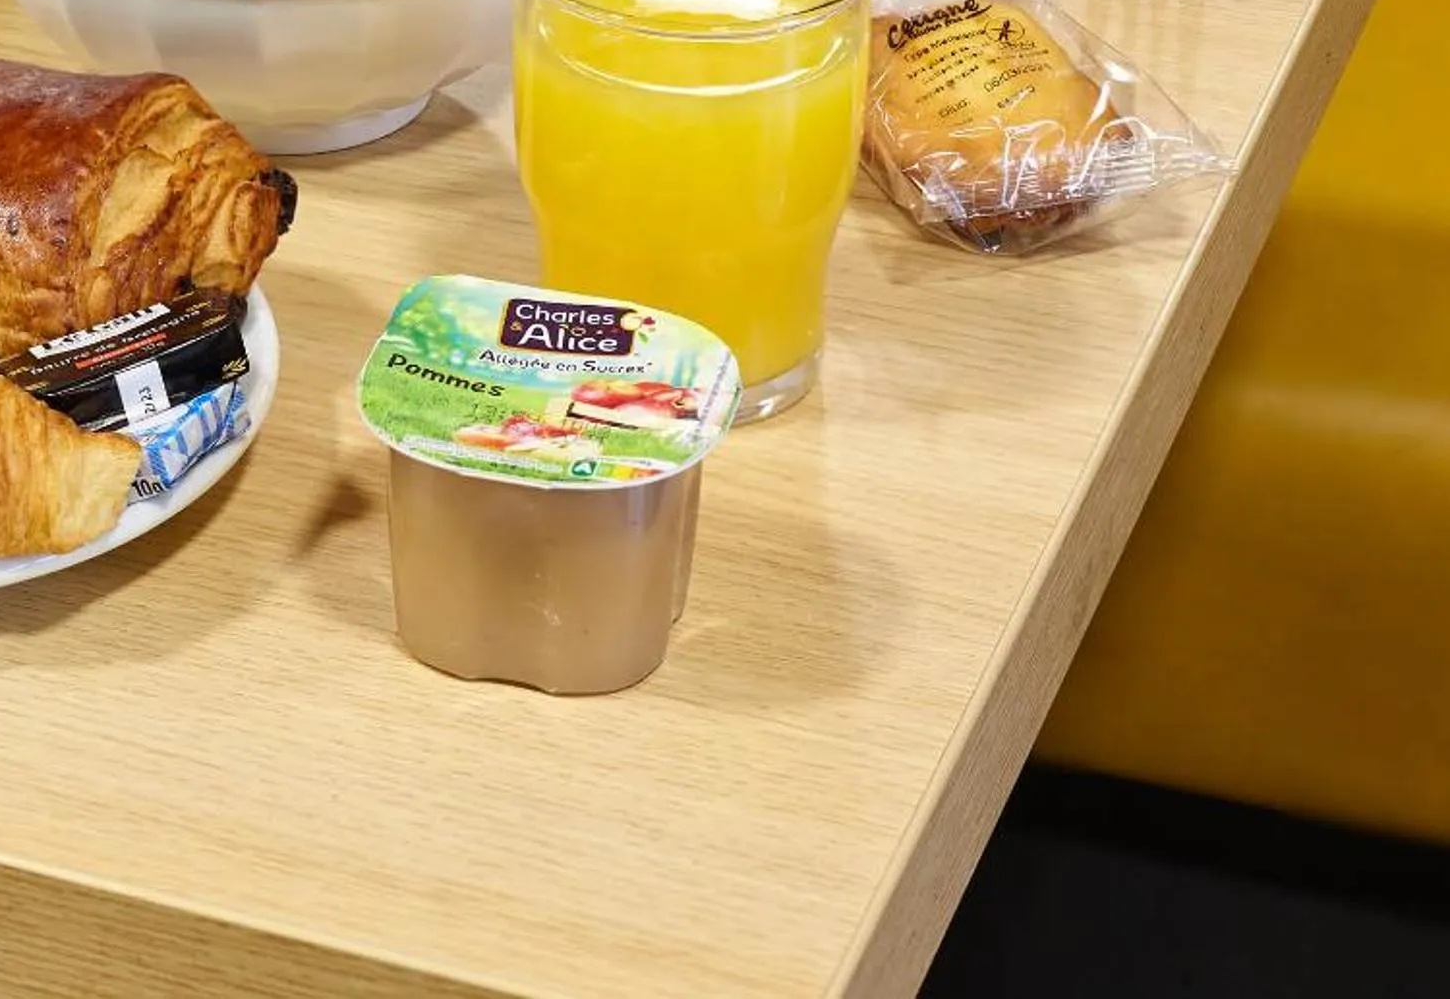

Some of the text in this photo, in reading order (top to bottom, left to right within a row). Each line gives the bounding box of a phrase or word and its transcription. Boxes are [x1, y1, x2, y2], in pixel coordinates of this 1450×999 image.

[515, 303, 615, 326] Charles
[517, 323, 619, 352] Alice
[387, 352, 505, 398] Pommes
[556, 362, 578, 373] en
